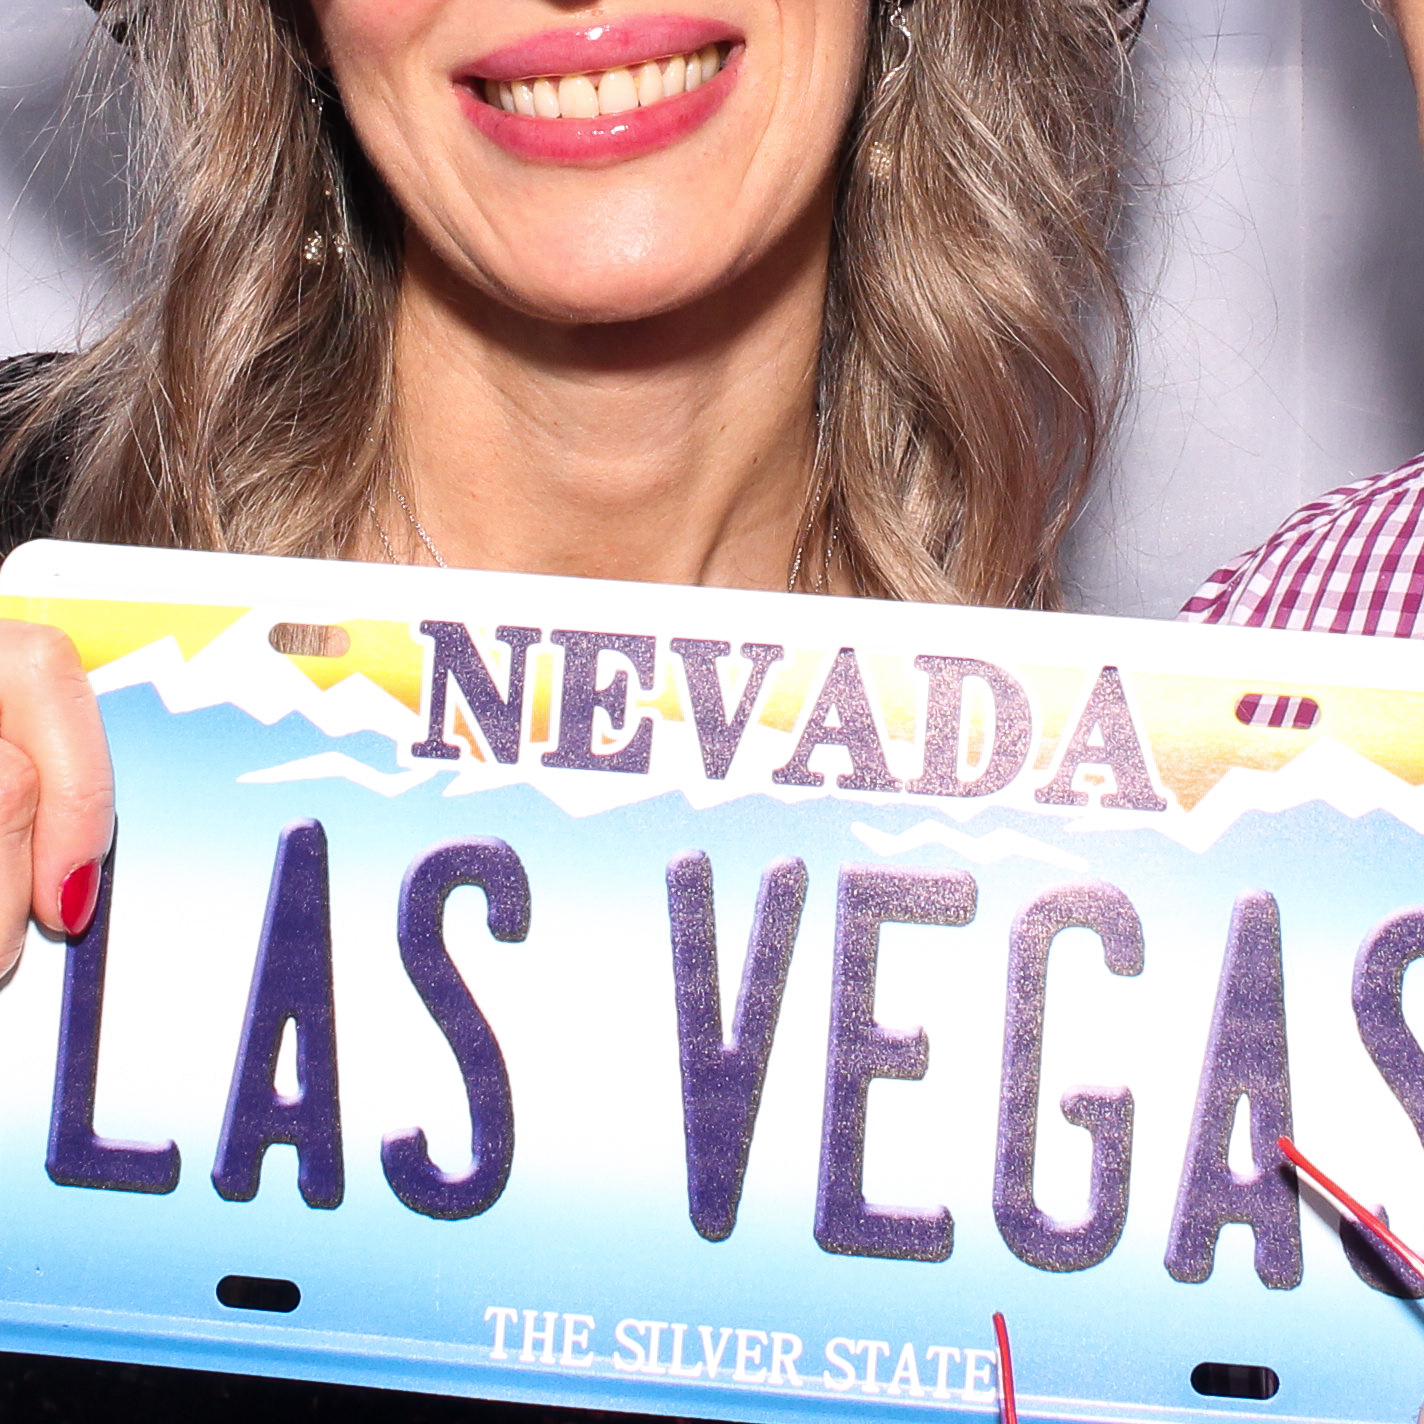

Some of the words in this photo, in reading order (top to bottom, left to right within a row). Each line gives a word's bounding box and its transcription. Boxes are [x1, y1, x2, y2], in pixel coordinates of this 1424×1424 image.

[410, 619, 1168, 812] NEVADA
[45, 814, 532, 1221] LAS
[483, 1305, 596, 1368] THE
[613, 1317, 804, 1388] SILVER
[823, 1336, 1001, 1403] STATE
